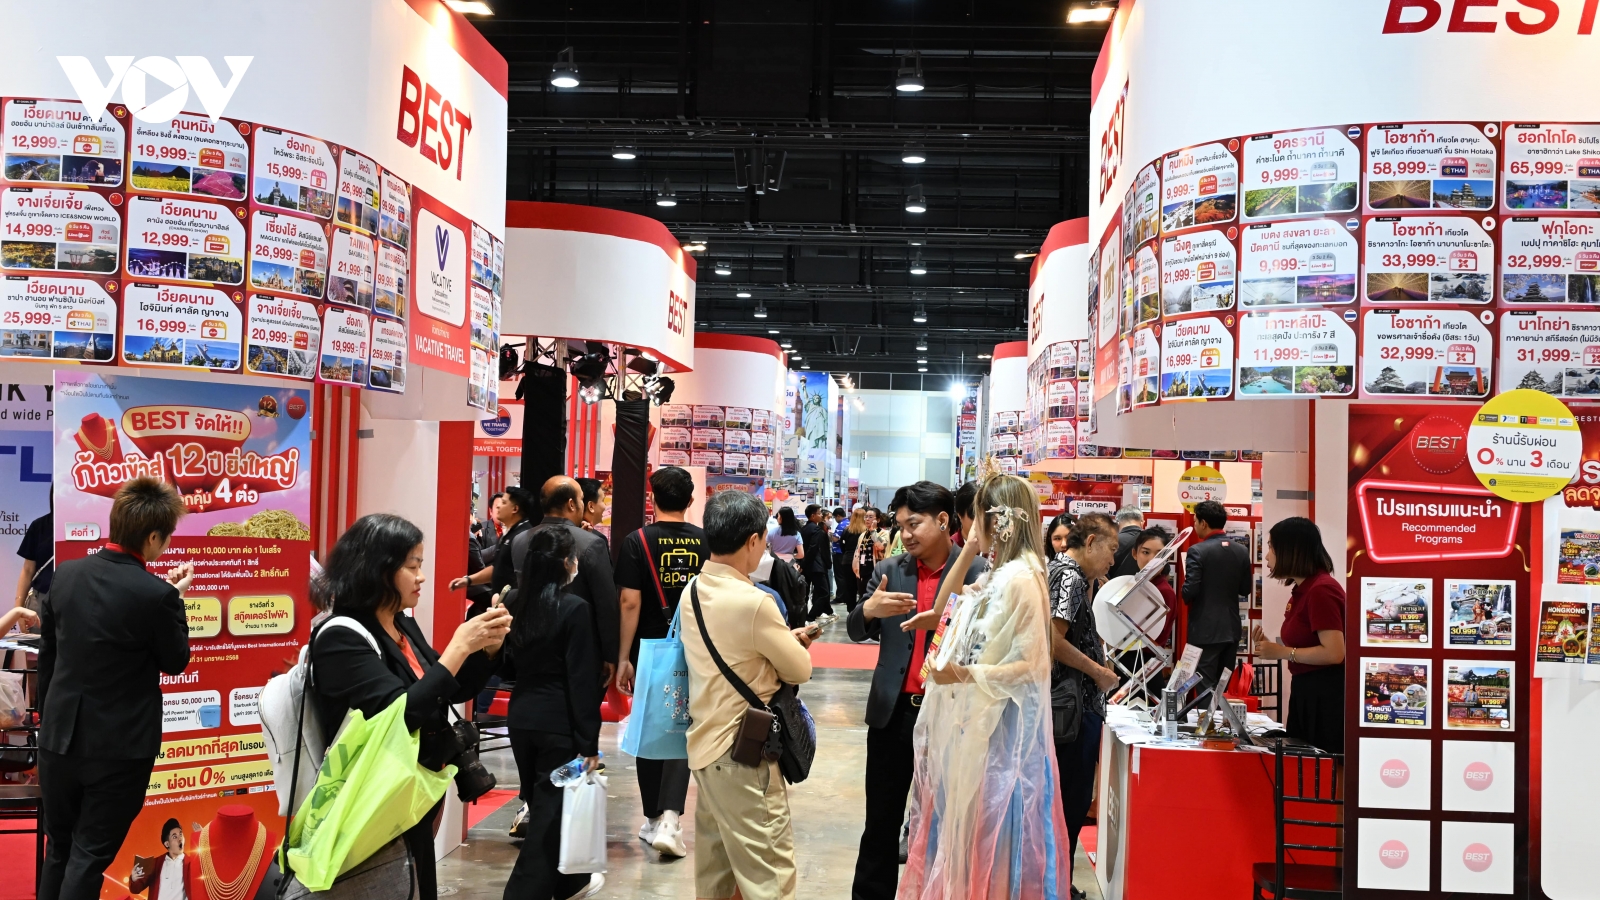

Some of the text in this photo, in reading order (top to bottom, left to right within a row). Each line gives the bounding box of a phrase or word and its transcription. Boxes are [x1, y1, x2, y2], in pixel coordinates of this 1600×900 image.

[24, 105, 81, 121] เวียดนาม
[171, 119, 214, 133] คุนหมิง
[397, 64, 472, 182] BEST
[1100, 72, 1129, 207] BEST
[1274, 131, 1324, 154] อุดรธานี
[1385, 129, 1435, 144] โอซาก้า
[1518, 129, 1576, 143] ฮอกไกโด
[286, 137, 315, 155] ฮ่องกง
[1373, 162, 1437, 176] 58,999.-
[1511, 161, 1573, 177] 65,999.-
[17, 192, 82, 210] จางเจี่ยเจี้ย
[161, 202, 217, 220] เวียดนาม
[266, 217, 296, 237] เซี่ยงไฮ้
[1393, 222, 1442, 236] โอซาก้า
[1542, 221, 1593, 239] ฟุกุโอกะ
[1261, 231, 1280, 239] เบตง
[1251, 241, 1280, 253] ปัตตานี
[1382, 254, 1446, 269] 33,999.-
[1508, 255, 1572, 270] 32,999.-
[27, 280, 84, 295] เวียดนาม
[431, 271, 452, 293] VACATIVE
[157, 289, 214, 305] เวียดนาม
[176, 306, 198, 315] ดาลัด
[257, 300, 301, 319] จางเจี่ยเจี้ย
[668, 290, 687, 337] BEST
[1266, 314, 1326, 329] เกาะหลีเป๊ะ
[1391, 314, 1440, 329] โอซาก้า
[1519, 316, 1569, 331] นาโกย่า
[1175, 324, 1210, 337] เวียดนาม
[415, 334, 466, 364] VACATIVE TRAVEL
[1381, 347, 1444, 362] 32,999.-
[1517, 349, 1580, 364] 31,999.-
[13, 410, 41, 420] wide
[131, 411, 243, 435] BEST จัดให้!!
[1416, 436, 1462, 450] BEST
[1492, 432, 1557, 447] ร้านนี้รับผ่อน
[167, 443, 206, 476] 12
[208, 452, 225, 476] ปี
[225, 447, 300, 489] ยิ่งใหญ่
[1530, 450, 1543, 467] 3
[215, 478, 258, 504] 4 ต่อ
[1376, 498, 1501, 519] โปรแกรมแนะนำ
[71, 525, 94, 538] ต่อที่ 1
[1402, 523, 1476, 533] Recommended
[1415, 534, 1463, 544] Programs
[167, 734, 238, 759] ลดมากที่สุด
[1382, 768, 1407, 777] BEST
[1466, 772, 1490, 780] BEST
[167, 774, 196, 790] ผ่อน
[1382, 849, 1406, 858] BEST
[1465, 852, 1489, 861] BEST
